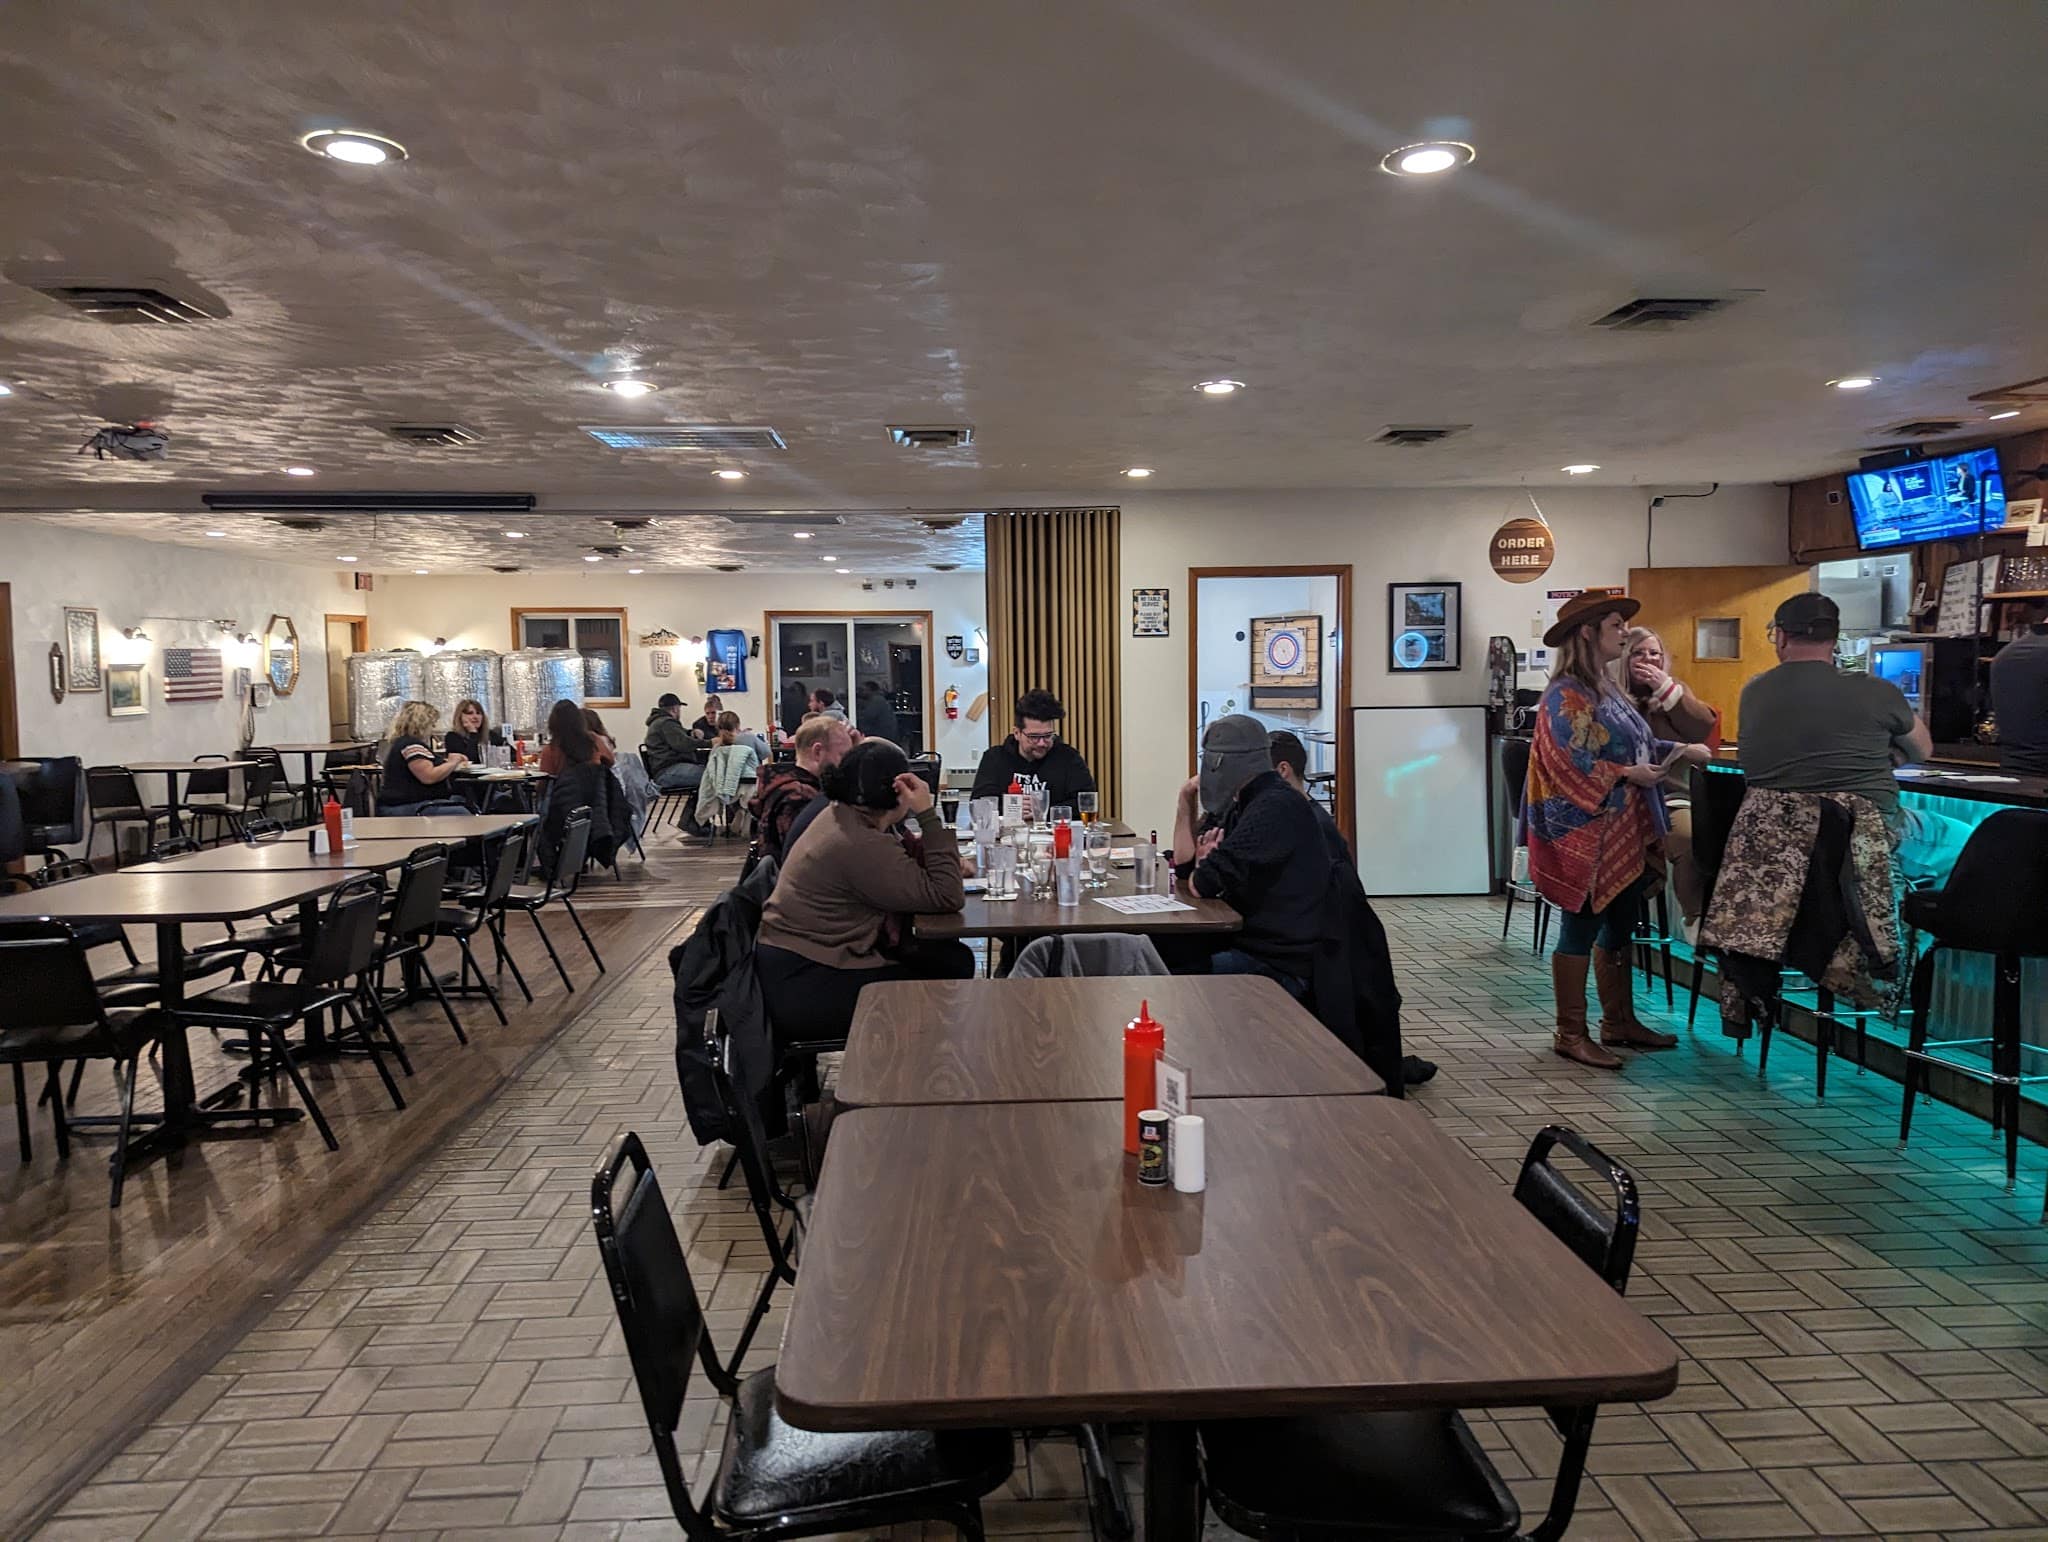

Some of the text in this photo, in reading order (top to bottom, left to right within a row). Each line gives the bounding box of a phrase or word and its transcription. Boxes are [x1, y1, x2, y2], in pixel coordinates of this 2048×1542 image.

[1498, 537, 1545, 549] ORDER
[1501, 555, 1540, 566] HERE
[1031, 773, 1040, 785] A
